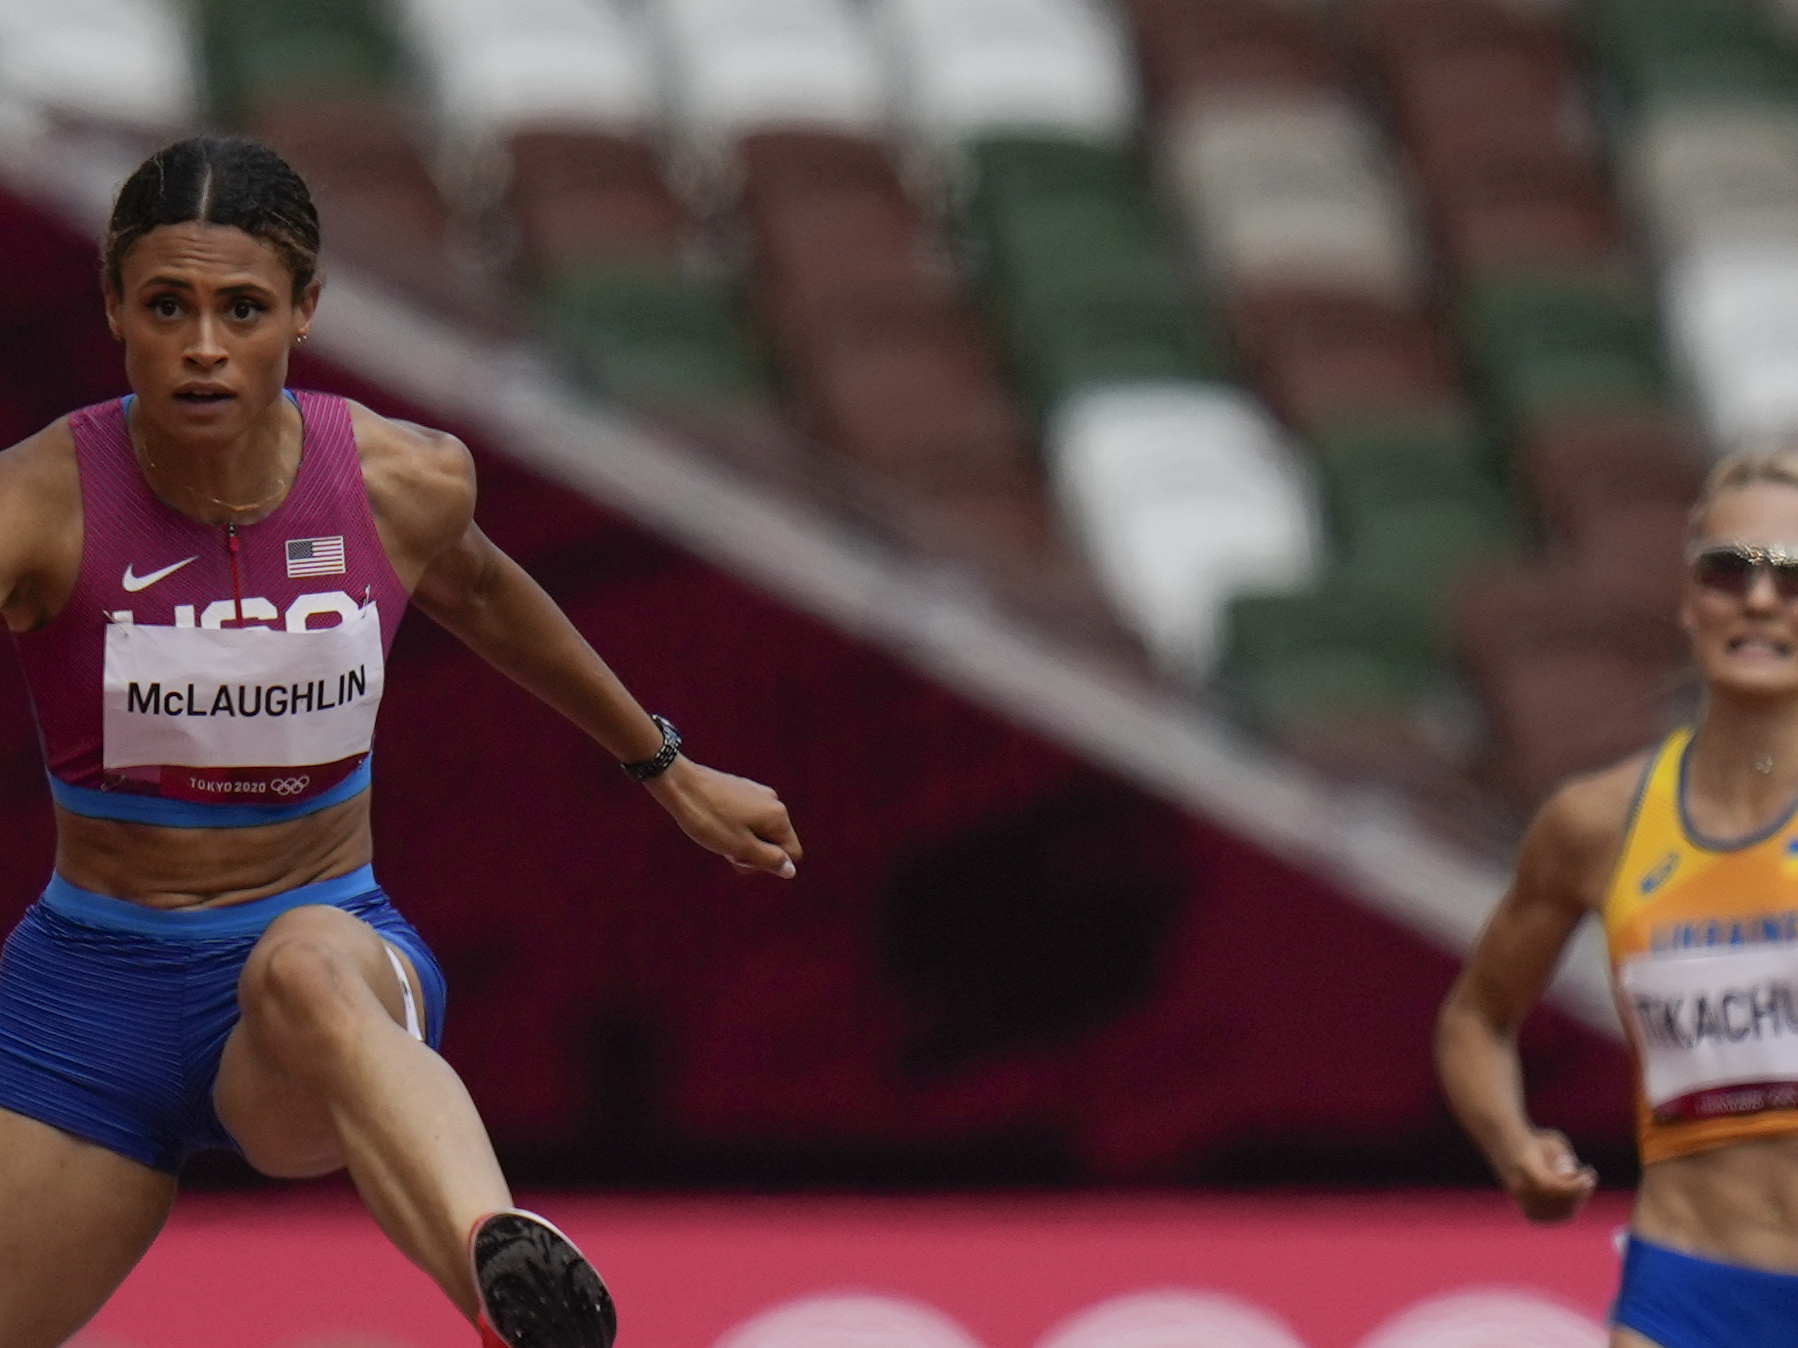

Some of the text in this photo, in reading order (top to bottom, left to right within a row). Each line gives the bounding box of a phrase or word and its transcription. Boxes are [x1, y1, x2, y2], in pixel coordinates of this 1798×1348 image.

[127, 664, 366, 718] McLAUGHLIN
[190, 777, 267, 794] TOKYO 2020
